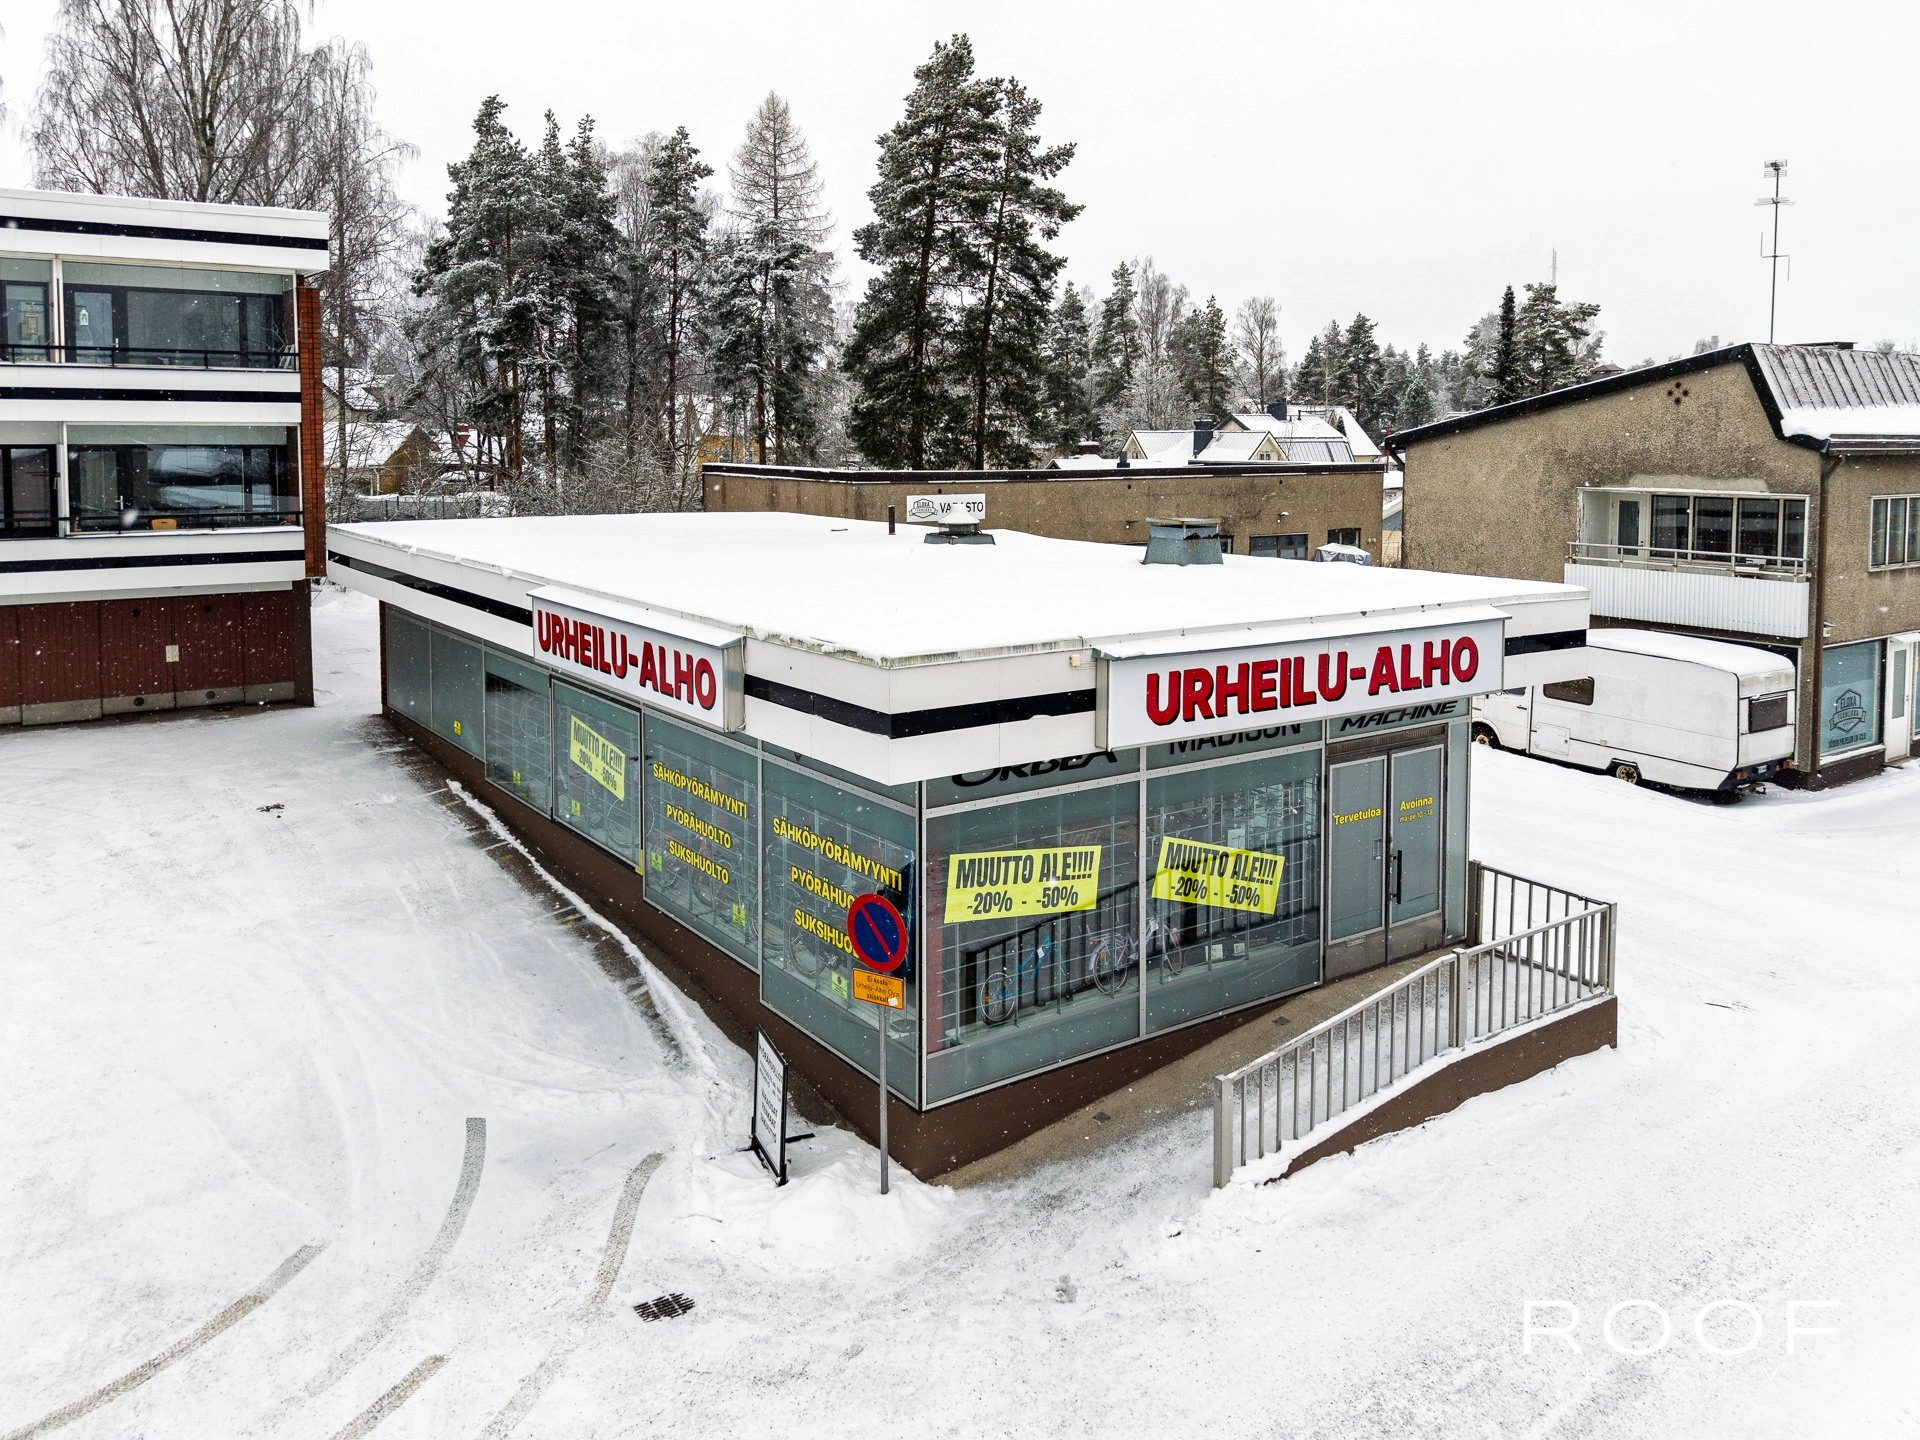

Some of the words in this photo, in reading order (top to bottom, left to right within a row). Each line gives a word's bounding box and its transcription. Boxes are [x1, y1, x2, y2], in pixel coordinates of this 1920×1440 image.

[940, 502, 984, 513] VASTO
[537, 609, 717, 711] URHEILU-ALHO
[1146, 636, 1479, 726] URHEILU-ALHO
[1340, 700, 1458, 731] MACHINE
[573, 720, 600, 758] MUUTTO
[653, 761, 748, 820] SÄHKÖPYÖRÄMYYNTI
[1399, 796, 1433, 812] Avoinna
[666, 804, 731, 849] PYÖRÄHUOLTO
[1334, 808, 1382, 825] Tervetuloa
[669, 840, 730, 884] SUKSIHUOLTO
[773, 816, 902, 891] SÄHKÖPYÖRÄMYYNTI
[956, 855, 1034, 889] MUUTTO
[1039, 851, 1095, 883] ALE!!!!
[1164, 842, 1229, 878] MUUTTO
[1230, 854, 1278, 885] ALE!!!!
[791, 866, 855, 911] PYÖRÄHUO
[967, 890, 1013, 914] -20%
[1036, 885, 1079, 908] -50%
[1171, 876, 1208, 900] -20%
[1226, 884, 1260, 907] -50%
[794, 908, 860, 959] SUKSIHUO
